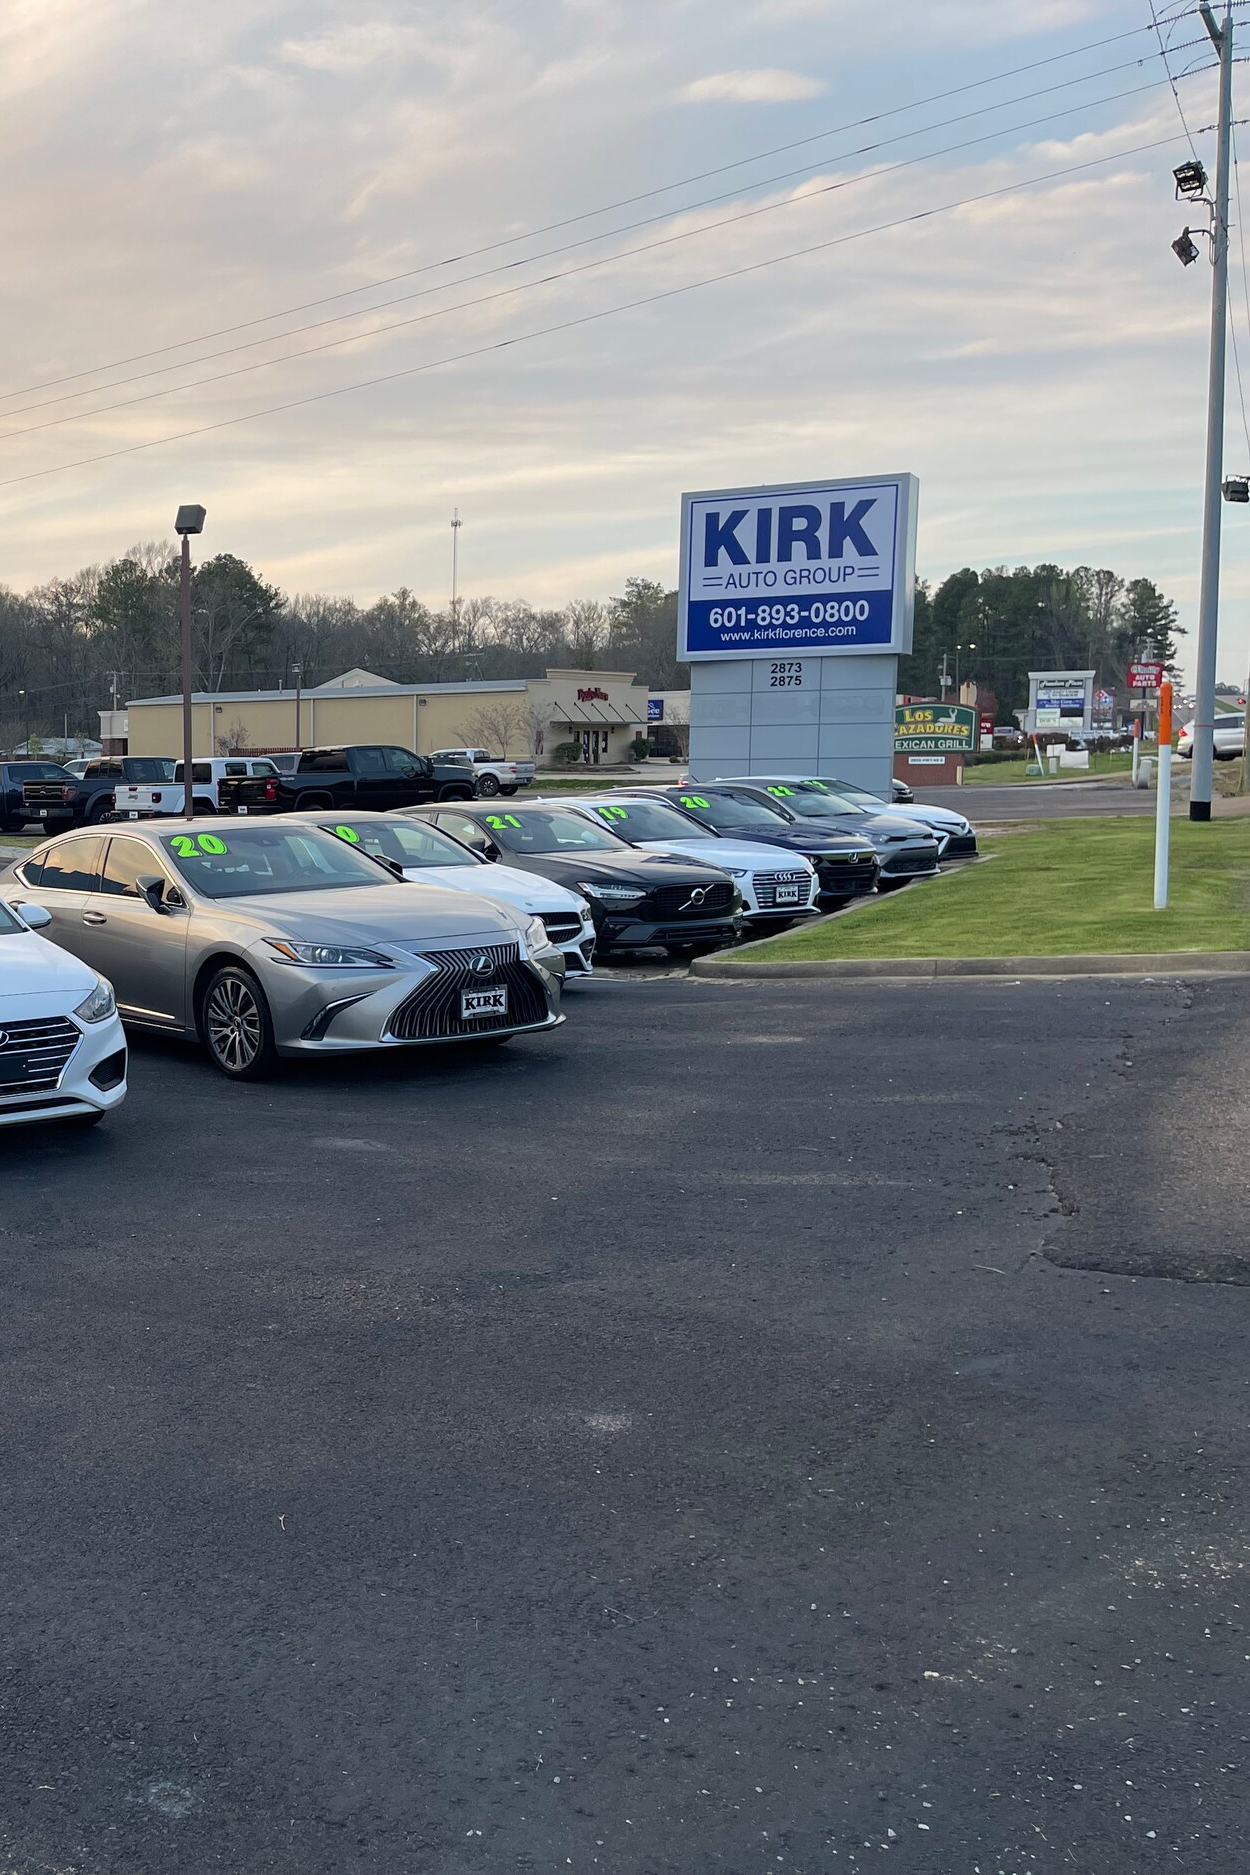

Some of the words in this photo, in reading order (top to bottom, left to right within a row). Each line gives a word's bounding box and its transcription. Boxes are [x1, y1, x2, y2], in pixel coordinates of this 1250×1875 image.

[703, 498, 879, 567] KIRK
[724, 570, 777, 590] AUTO
[783, 565, 855, 586] GROUP
[709, 600, 870, 628] 601-893-0800
[720, 625, 856, 641] www.kirkflorence.com
[770, 662, 802, 674] 2873
[770, 676, 802, 686] 2875
[895, 740, 935, 749] EXICAN
[937, 740, 969, 749] GRILL
[767, 785, 796, 797] 22
[680, 796, 710, 808] 20
[598, 806, 629, 820] 19
[485, 814, 522, 830] 21
[170, 833, 228, 858] 20
[778, 890, 797, 898] KIRK
[464, 994, 504, 1011] KIRK
